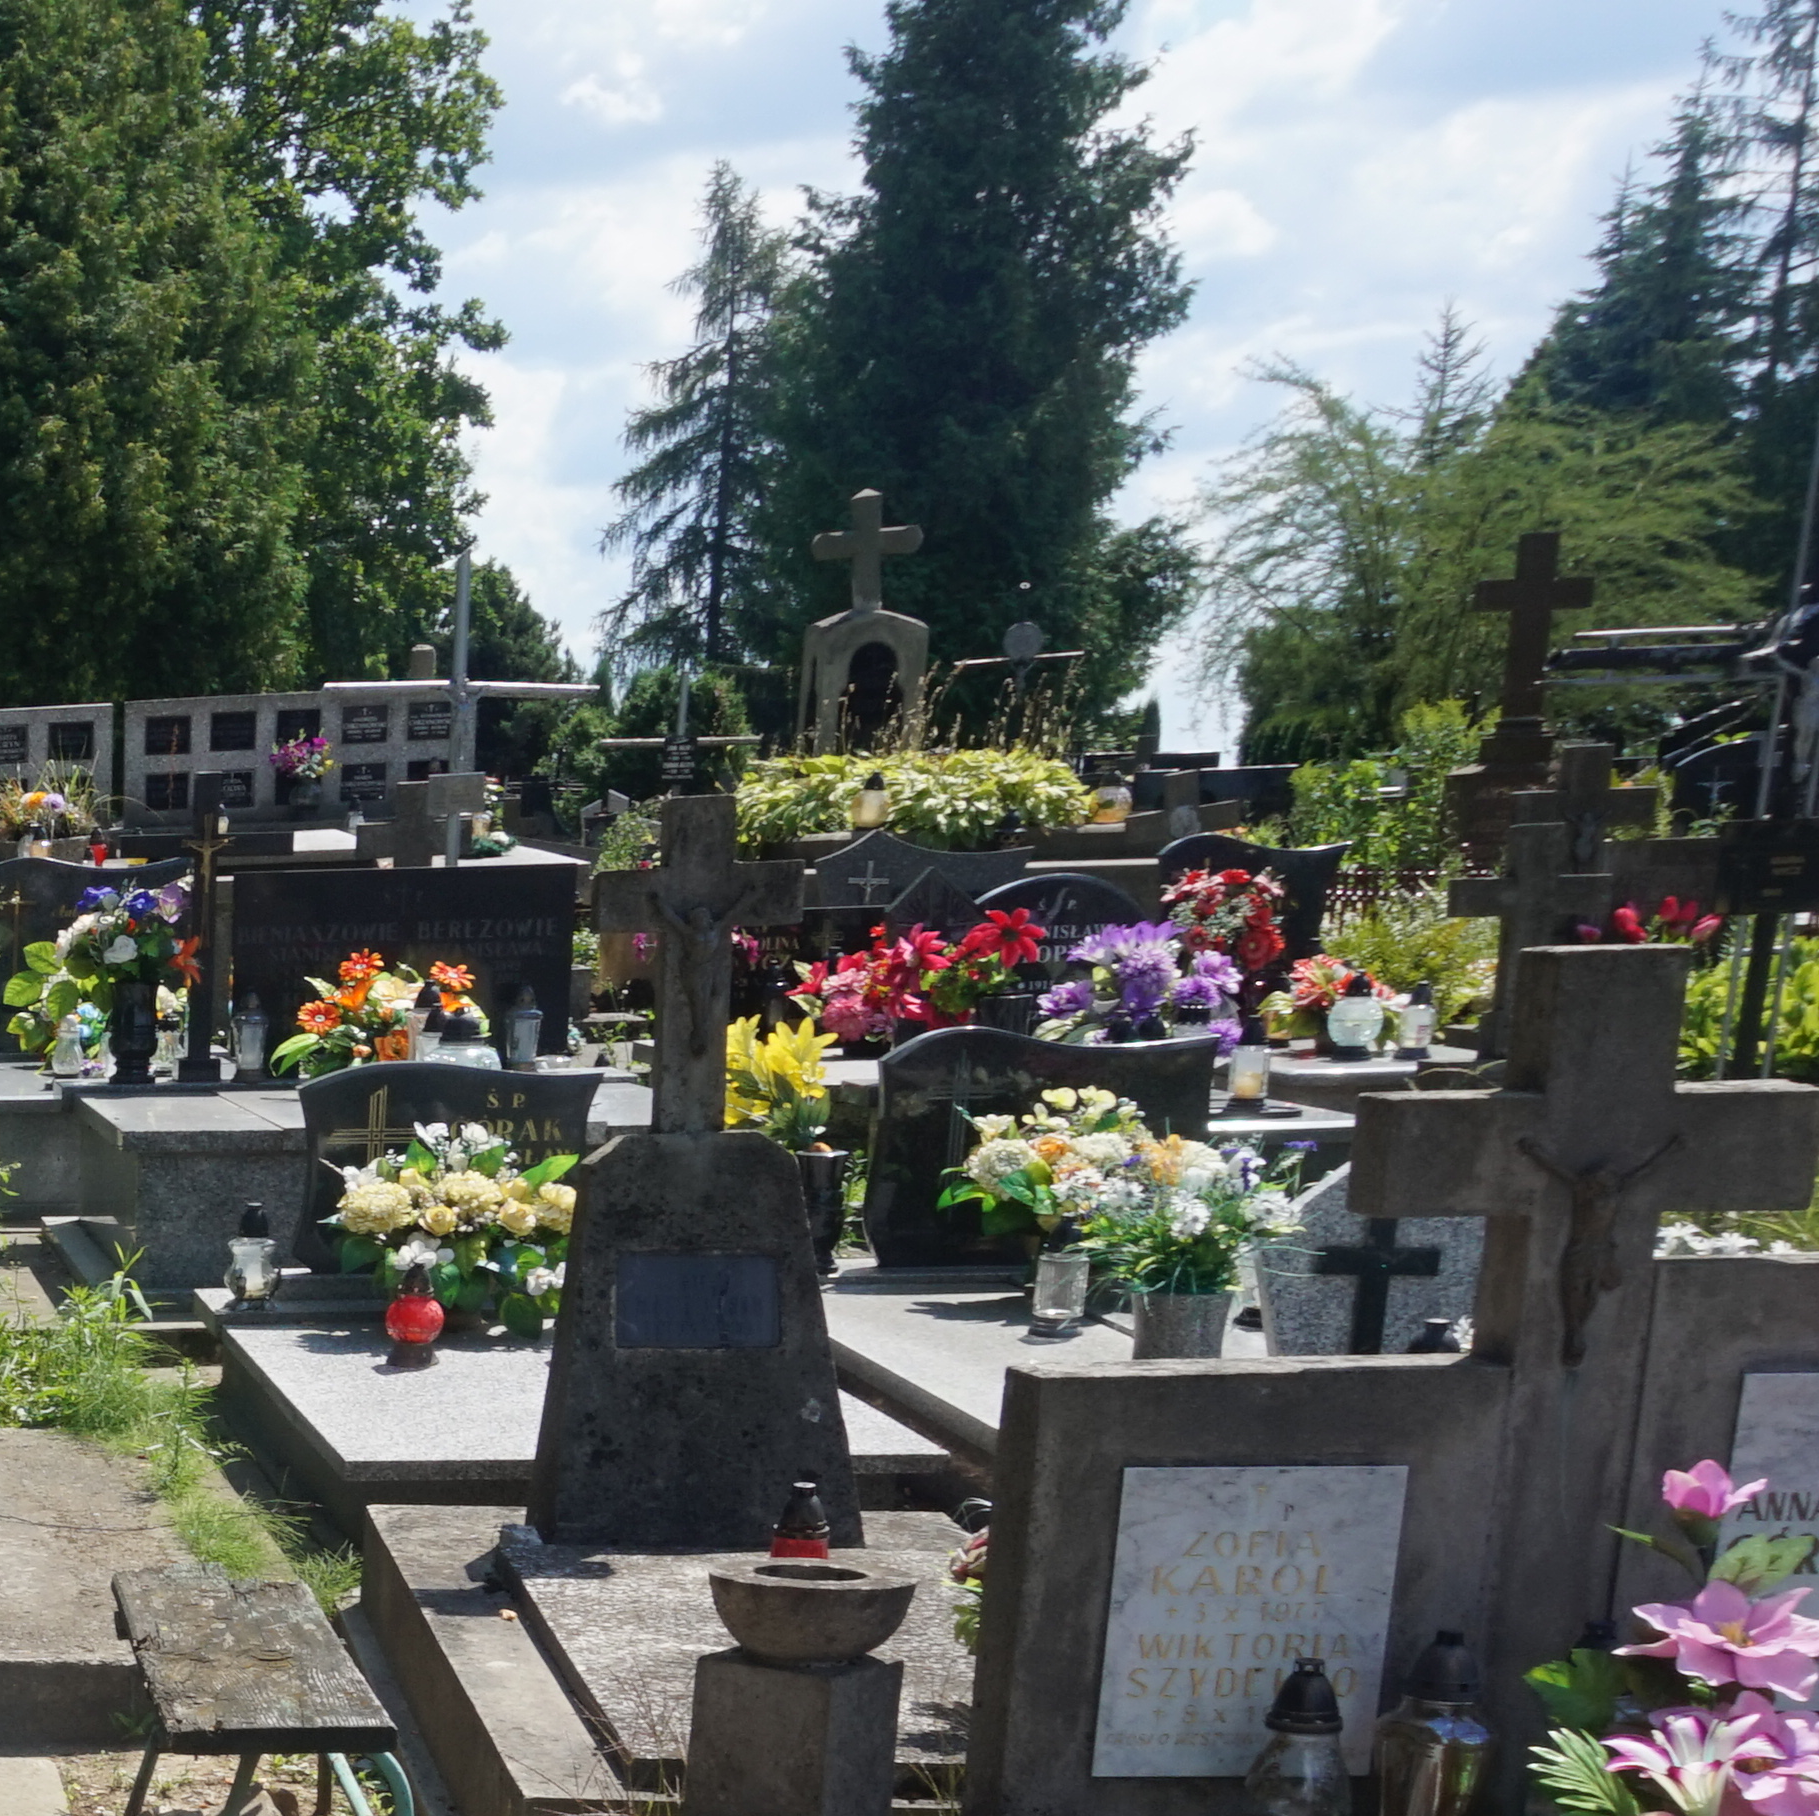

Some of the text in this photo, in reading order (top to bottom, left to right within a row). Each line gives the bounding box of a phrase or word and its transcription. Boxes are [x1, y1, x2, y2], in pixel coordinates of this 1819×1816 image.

[1182, 1530, 1322, 1558] ZOFIA
[1151, 1564, 1333, 1597] KAROL
[1137, 1632, 1351, 1660] WIKTORIA
[1125, 1666, 1358, 1700] SZYDEO
